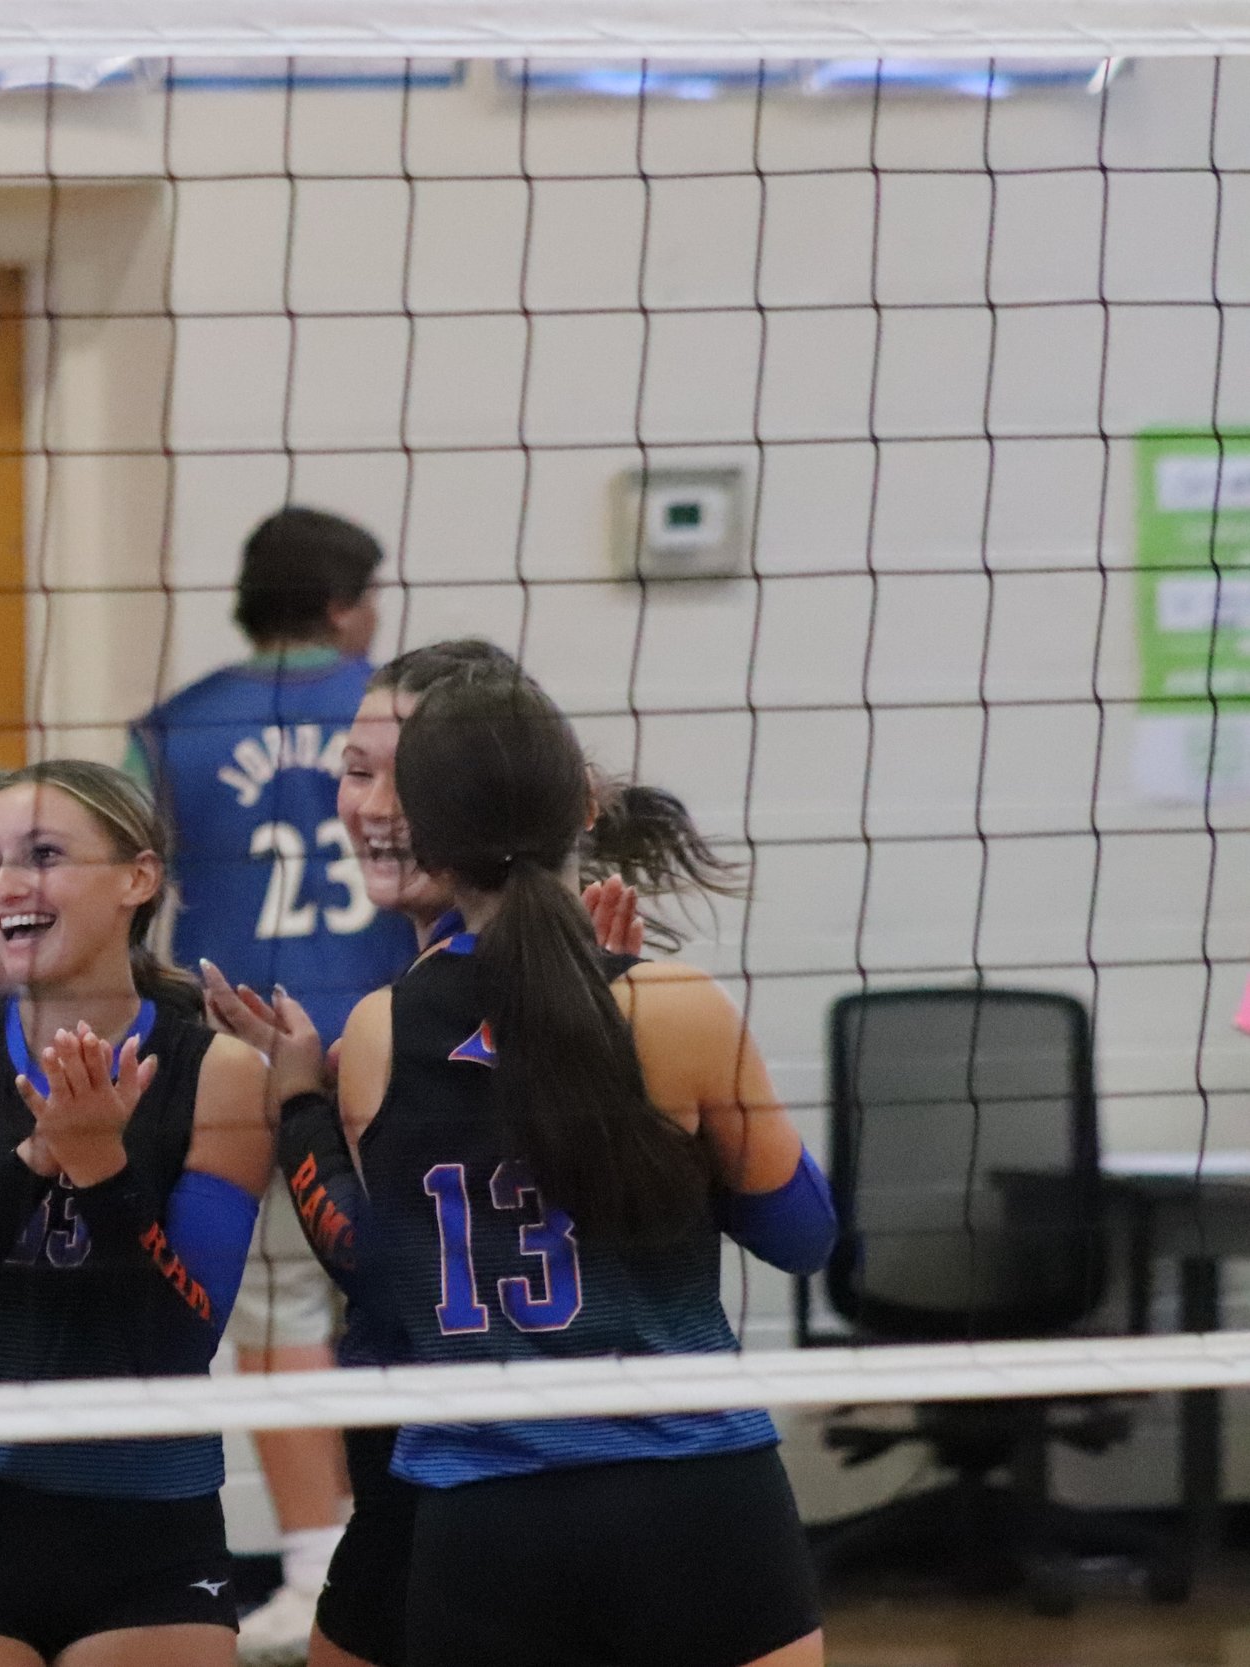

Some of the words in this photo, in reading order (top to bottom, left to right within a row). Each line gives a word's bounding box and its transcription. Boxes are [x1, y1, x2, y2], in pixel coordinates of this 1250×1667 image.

[217, 723, 352, 807] JORDA
[251, 819, 378, 941] 23
[422, 1160, 584, 1336] 13
